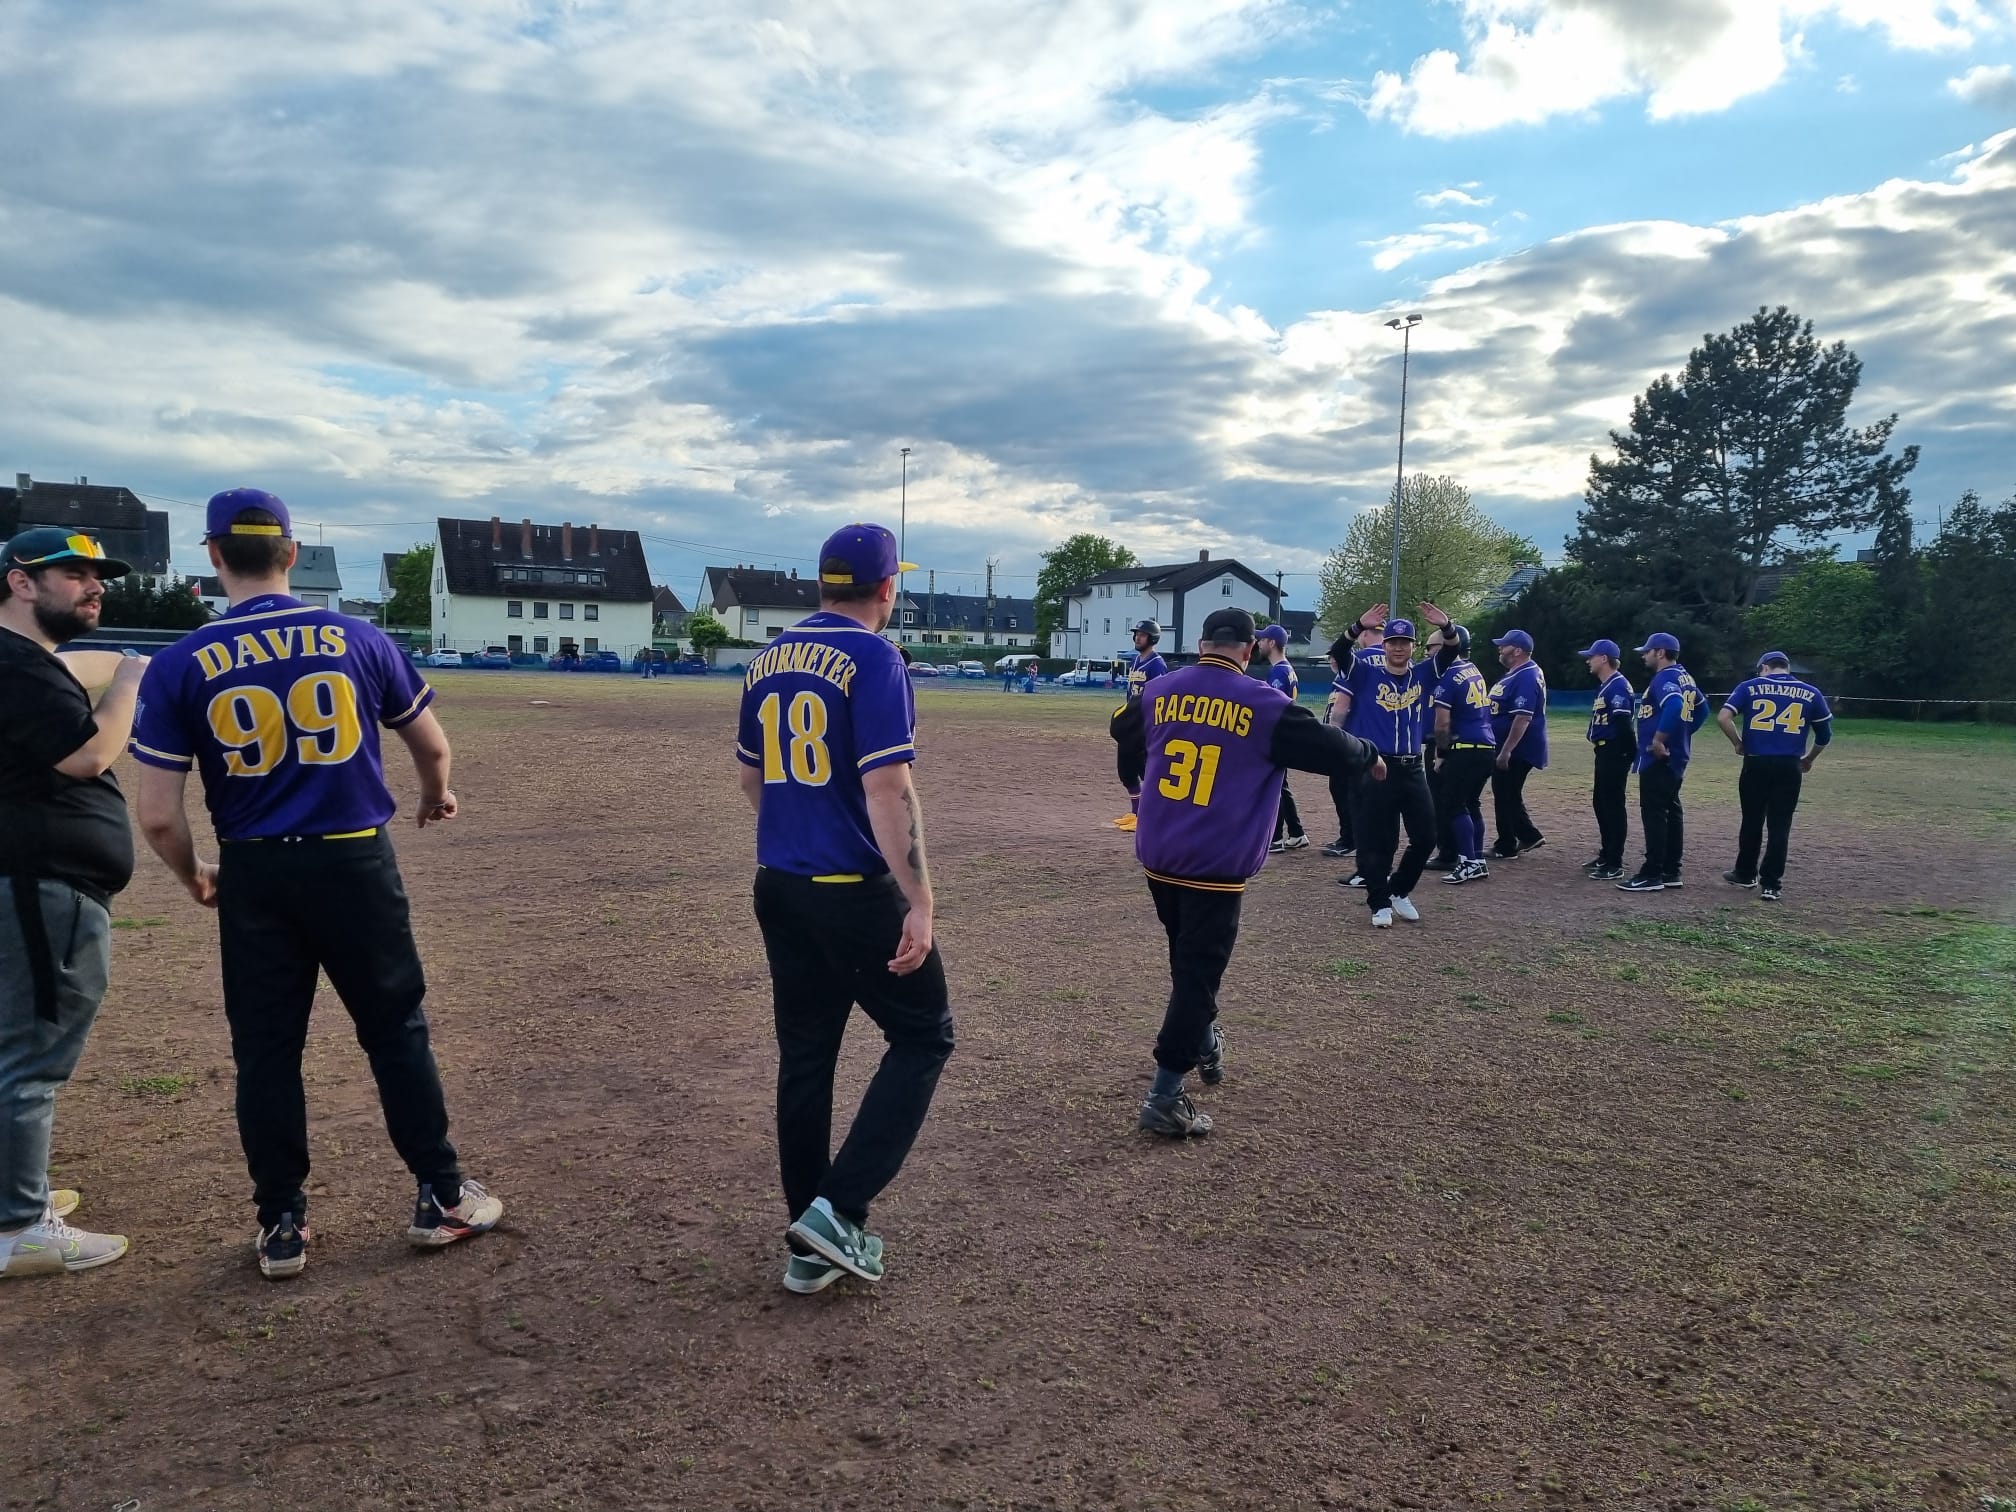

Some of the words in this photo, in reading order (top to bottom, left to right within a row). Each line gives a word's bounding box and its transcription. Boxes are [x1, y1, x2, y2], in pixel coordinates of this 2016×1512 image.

[192, 624, 346, 681] DAVIS
[744, 642, 857, 698] THORMEYER
[1154, 694, 1254, 737] RACOONS
[1465, 678, 1491, 708] 42
[1750, 698, 1806, 735] 24
[207, 671, 362, 777] 99
[757, 690, 832, 787] 18
[1158, 738, 1221, 807] 31
